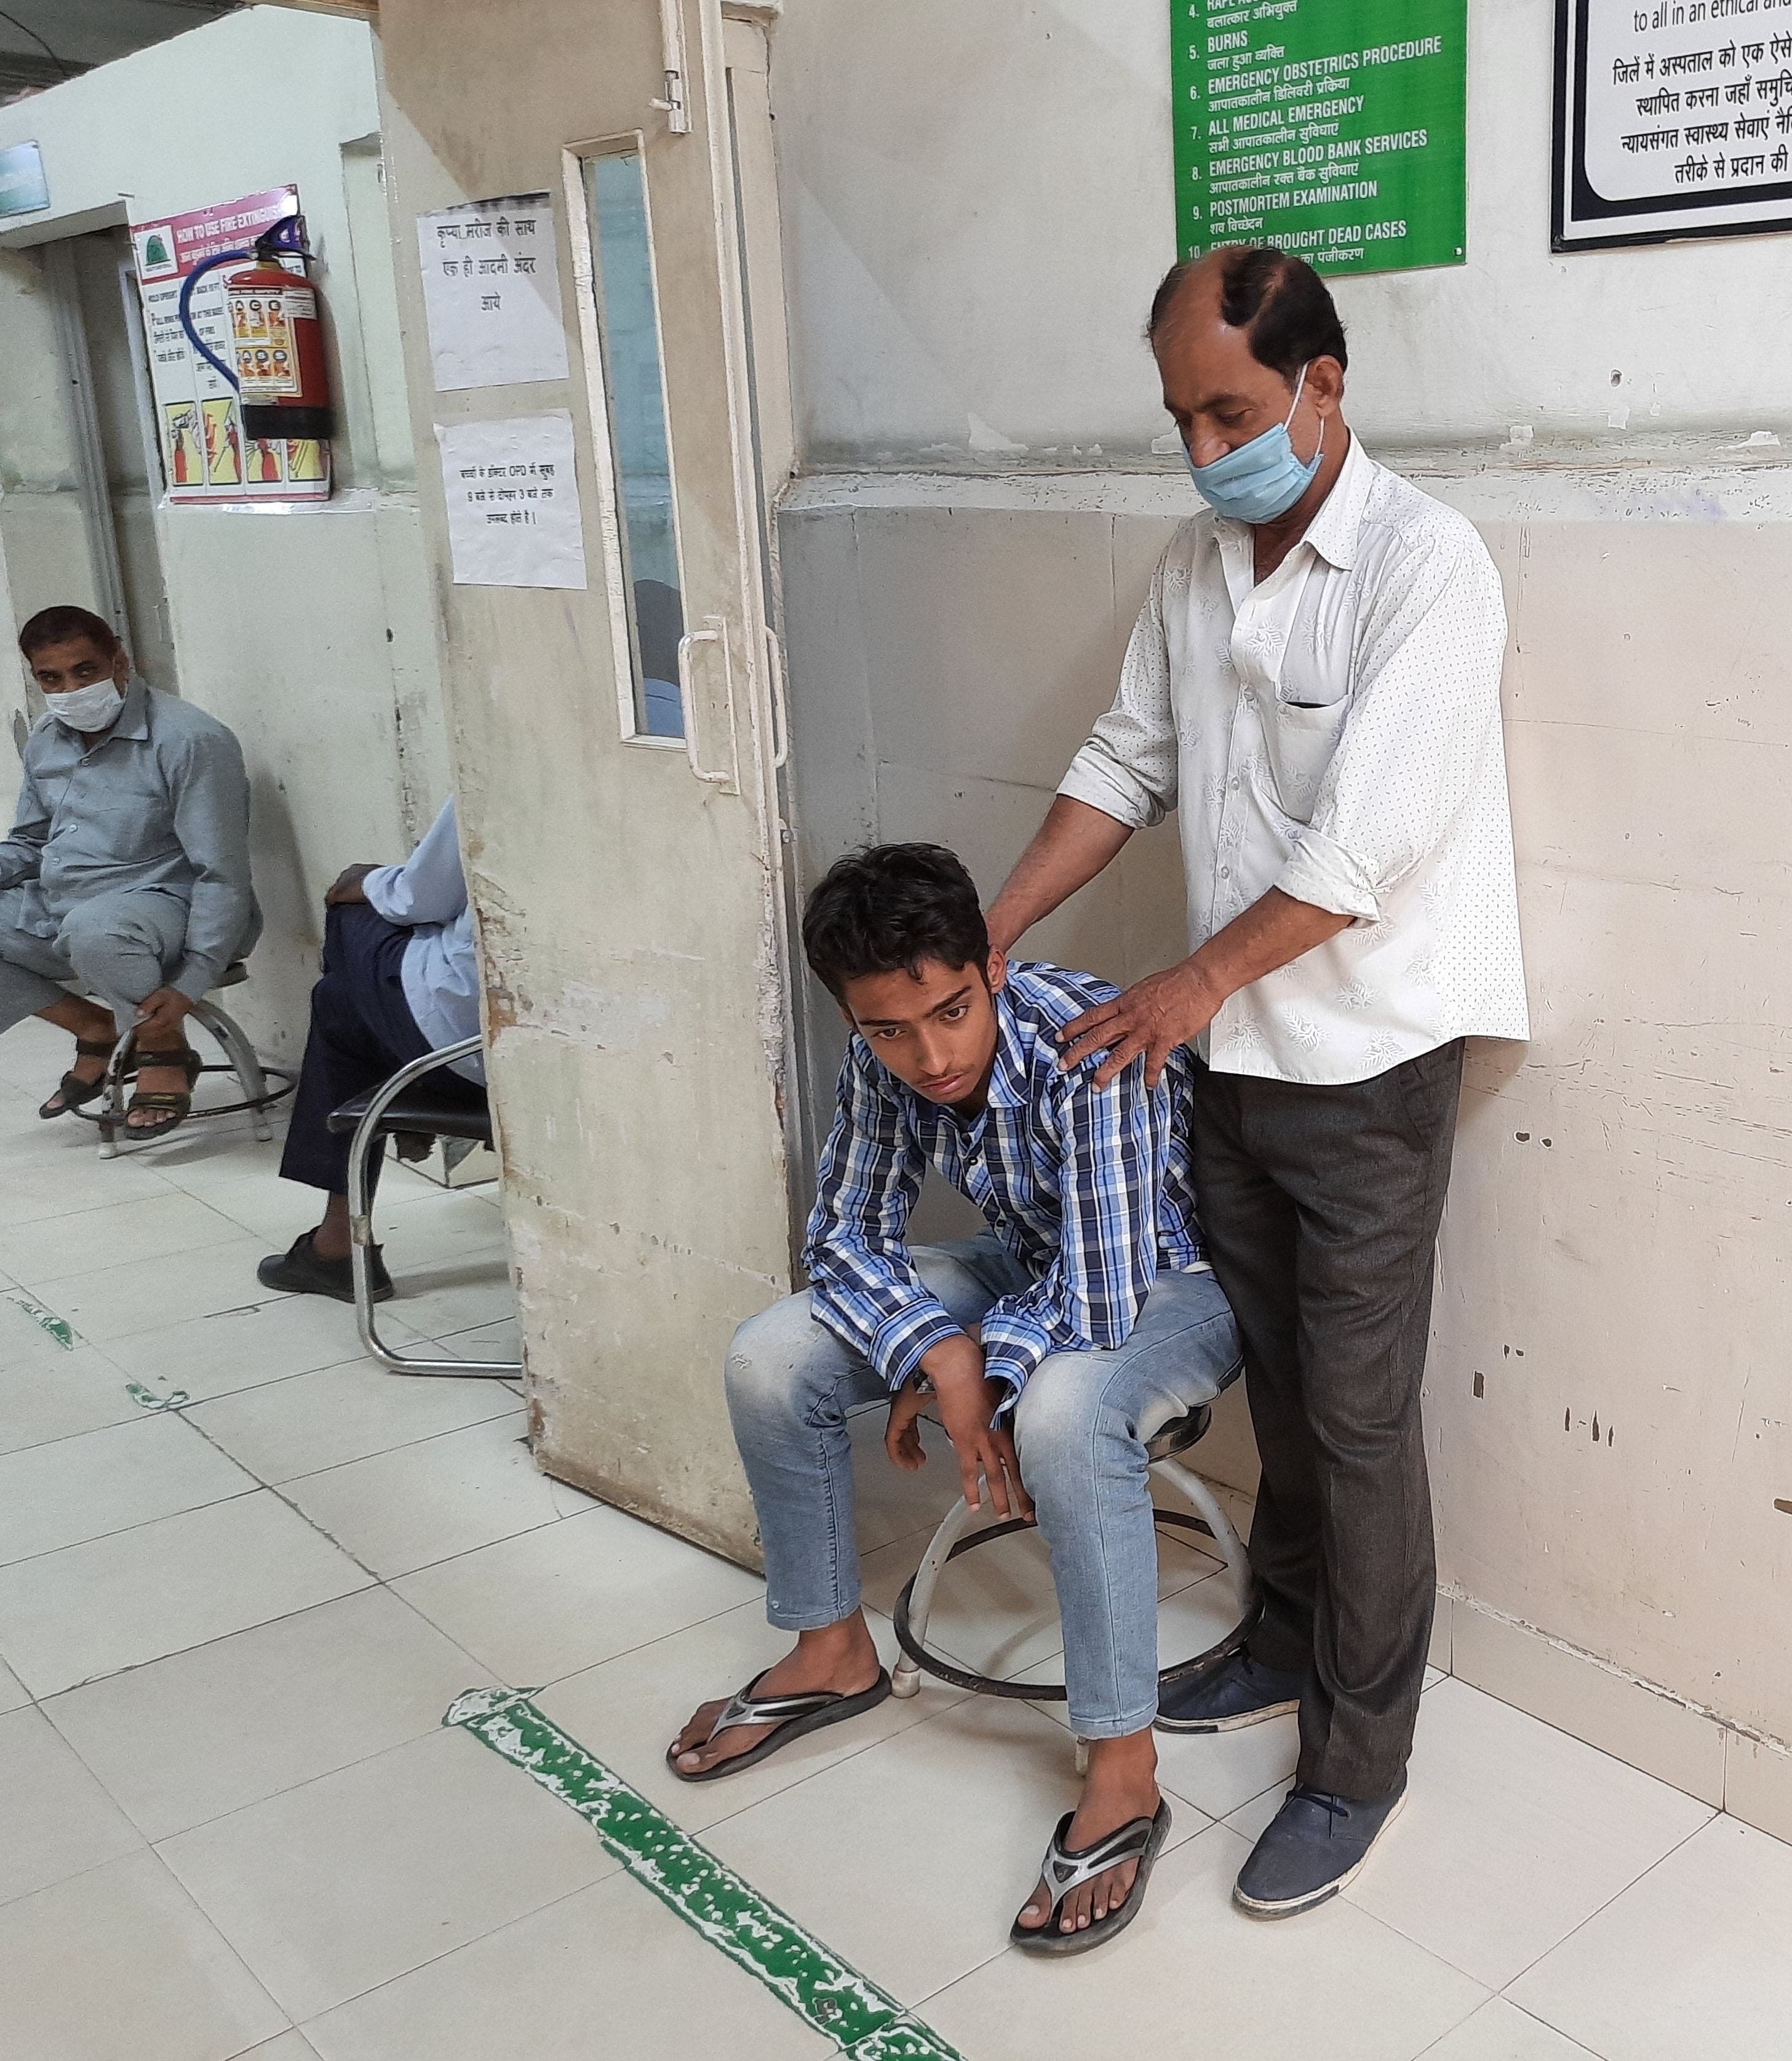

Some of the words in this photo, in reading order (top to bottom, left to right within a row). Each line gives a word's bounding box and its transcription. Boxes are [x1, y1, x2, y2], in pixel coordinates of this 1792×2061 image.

[1189, 4, 1200, 18] 4.
[1252, 1, 1297, 20] अभियुक्त
[1635, 10, 1647, 32] to
[1652, 1, 1667, 29] all
[1672, 1, 1684, 25] in
[1689, 2, 1705, 22] an
[1189, 45, 1200, 60] 5.
[1207, 30, 1248, 53] BURNS
[1645, 53, 1655, 80] में
[1659, 50, 1713, 78] अस्पताल
[1718, 39, 1735, 68] को
[1741, 42, 1764, 70] एक
[1190, 86, 1201, 100] 6.
[1208, 68, 1278, 95] EMERGENCY
[1283, 52, 1358, 83] OBSTETRICS
[1363, 35, 1442, 66] PROCEDURE
[1207, 57, 1230, 71] जला
[1232, 52, 1252, 71] हुआ
[1208, 89, 1270, 112] आपातकालीन
[1273, 80, 1313, 101] डिलिवरी
[1636, 87, 1679, 117] स्थापित
[1685, 87, 1719, 110] करना
[1724, 74, 1752, 105] जहाँ
[1190, 126, 1201, 140] 7.
[1208, 118, 1229, 136] ALL
[1233, 109, 1284, 132] MEDICAL
[1288, 95, 1364, 122] EMERGENCY
[1620, 124, 1679, 154] न्यायसंगत
[1684, 122, 1729, 146] स्वास्थ्य
[1734, 111, 1770, 141] सेवाएं
[1192, 167, 1201, 180] 8.
[1209, 152, 1280, 177] EMERGENCY
[1283, 145, 1323, 165] BLOOD
[1328, 138, 1361, 159] BANK
[1365, 129, 1427, 154] SERVICES
[1208, 136, 1229, 154] सभी
[1232, 126, 1296, 150] आपातकालीन
[1674, 154, 1708, 184] तरीके
[1713, 151, 1725, 178] से
[1730, 154, 1765, 178] प्रदान
[1770, 143, 1788, 173] की
[1209, 172, 1271, 194] आपातकालीन
[1193, 206, 1203, 220] 9.
[1210, 192, 1290, 217] POSTMORTEM
[1294, 180, 1377, 206] EXAMINATION
[1209, 222, 1225, 236] शव
[1267, 229, 1325, 250] BROUGHT
[1329, 225, 1361, 244] DEAD
[1365, 220, 1407, 239] CASES
[463, 255, 473, 277] ही
[1318, 245, 1364, 263] पंजीकरण
